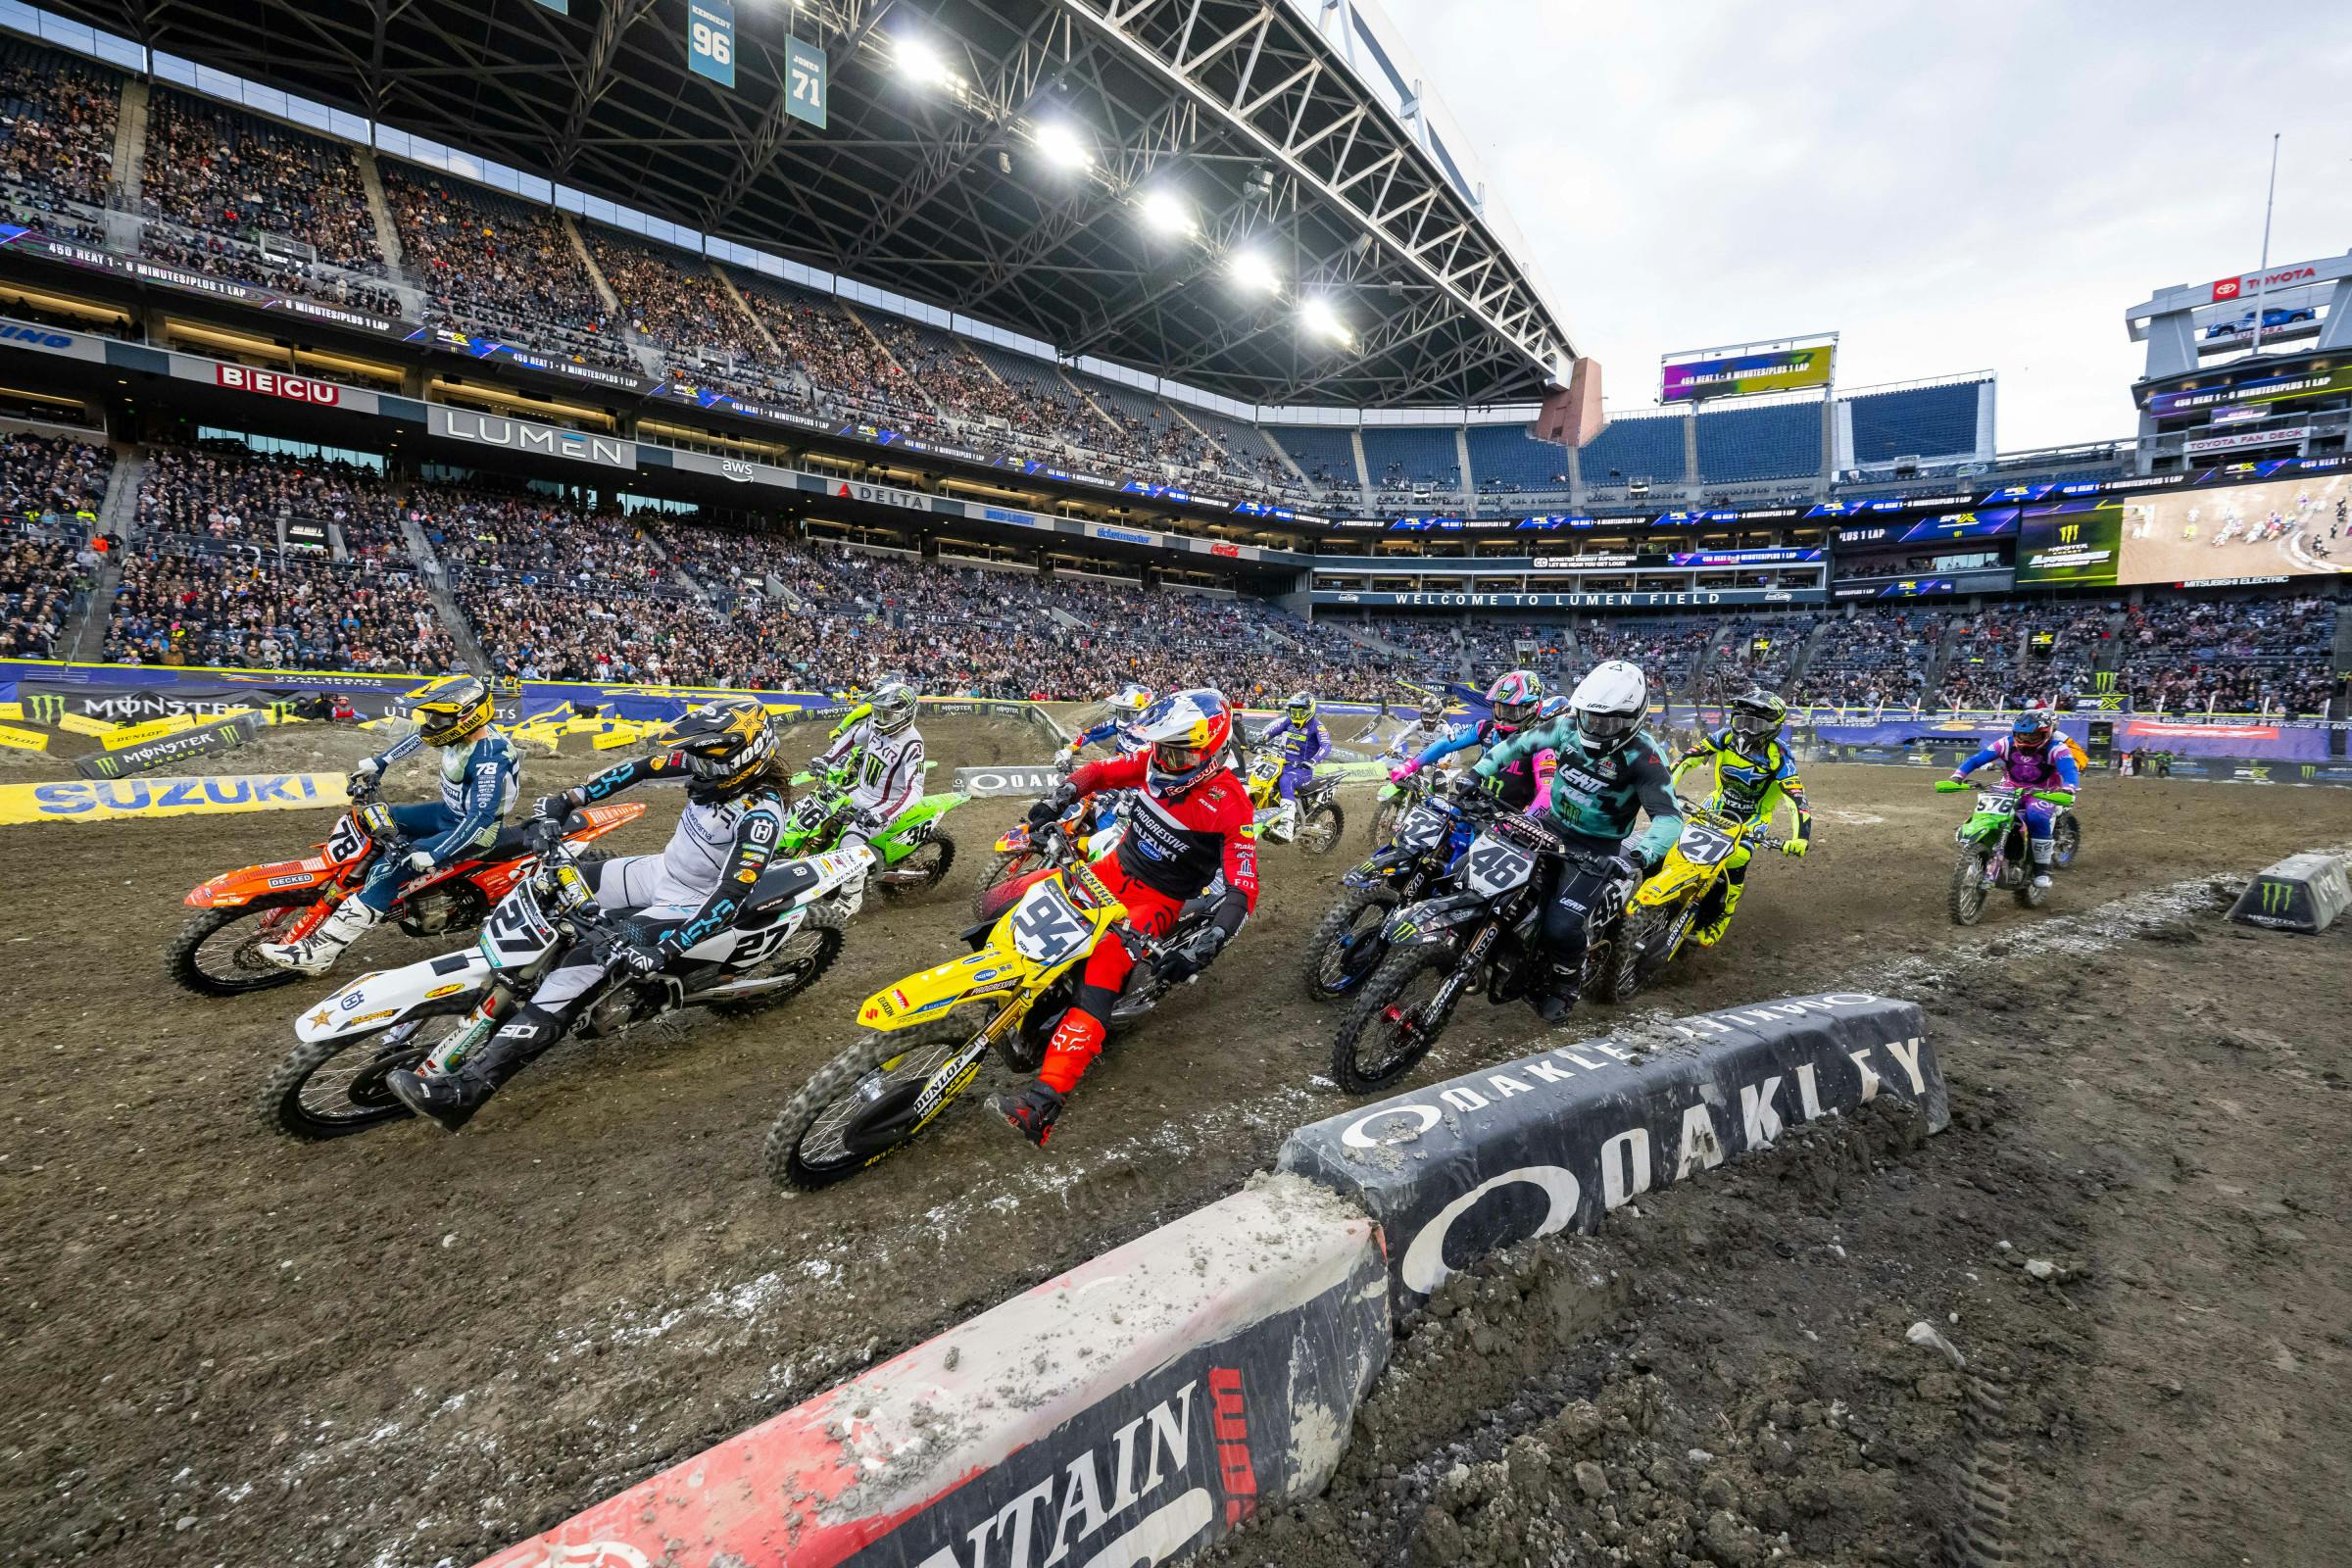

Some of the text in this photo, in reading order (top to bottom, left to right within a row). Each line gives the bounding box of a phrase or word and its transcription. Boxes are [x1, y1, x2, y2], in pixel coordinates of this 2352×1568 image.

[692, 5, 731, 29] KENNEDY
[693, 23, 730, 65] 96
[793, 54, 819, 74] JONES
[792, 69, 820, 107] 71
[49, 242, 73, 257] 450
[75, 249, 104, 265] HEAT
[108, 257, 114, 268] 1
[137, 264, 216, 292] MINUTES/PLUS
[219, 282, 224, 293] 1
[226, 284, 246, 298] LAP
[2246, 267, 2316, 289] TOYOTA
[295, 301, 364, 325] MINUTES/PLUS
[366, 318, 370, 327] 1
[372, 319, 390, 331] LAP
[0, 323, 73, 349] ING
[513, 353, 528, 363] 450
[529, 356, 548, 368] HEAT
[567, 365, 618, 384] MINUTES/PLUS
[625, 377, 638, 388] LAP
[1681, 376, 1694, 385] 450
[1696, 374, 1714, 384] HEAT
[1733, 367, 1788, 379] MINUTES/PLUS
[1794, 363, 1809, 371] LAP
[2174, 398, 2191, 408] 450
[2193, 395, 2213, 406] HEAT
[2236, 381, 2303, 398] MINUTES/PLUS
[2312, 376, 2331, 387] LAP
[731, 403, 744, 413] 450
[745, 404, 759, 415] HEAT
[819, 420, 829, 429] LAP
[447, 411, 621, 465] LUMEN
[2190, 428, 2303, 450] TOYOTA FAN DECK
[722, 460, 753, 475] aws
[2300, 460, 2317, 468] 450
[2319, 457, 2339, 466] HEAT
[860, 486, 923, 510] DELTA
[1939, 513, 1978, 523] SMX
[1097, 526, 1152, 544] ticketmaster
[1861, 529, 1866, 540] 1
[1868, 528, 1886, 539] LAP
[2184, 575, 2289, 588] MITSUBISHI ELECTRIC
[1396, 593, 1721, 606] WELCOME TO LUMEN FIELD
[817, 706, 854, 715] MONSTER
[996, 706, 1019, 714] MONSTER
[2077, 697, 2124, 710] SMX
[461, 712, 484, 734] FORCE
[117, 730, 163, 742] DUNLOP
[122, 732, 216, 763] MONSTER
[144, 747, 205, 767] ENERGY
[476, 761, 498, 776] 78
[1254, 763, 1278, 780] 45
[1558, 763, 1609, 794] LEATT
[34, 773, 318, 814] SUZUKI
[1321, 790, 1334, 804] 45
[1977, 799, 2013, 812] 576
[328, 819, 359, 863] 78
[906, 820, 932, 847] 36
[1132, 821, 1177, 862] SUZUKI
[1134, 806, 1191, 854] PROGRESSIVE
[1681, 831, 1727, 863] 21
[834, 861, 864, 884] DUNLOP
[1471, 846, 1529, 889] 46
[271, 875, 311, 886] DECKED
[1559, 898, 1587, 912] LEATT
[490, 899, 546, 953] 27
[1015, 895, 1079, 958] 94
[2248, 913, 2296, 926] MONSTER
[736, 921, 791, 959] 27
[970, 978, 1018, 996] PROGRESSIVE
[351, 1009, 393, 1025] ROCKSTAR
[457, 1020, 488, 1056] MOTOREX
[913, 1056, 965, 1112] DUNLOP
[945, 1061, 977, 1095] ACERBIS
[1439, 1041, 1639, 1113] OAKLE
